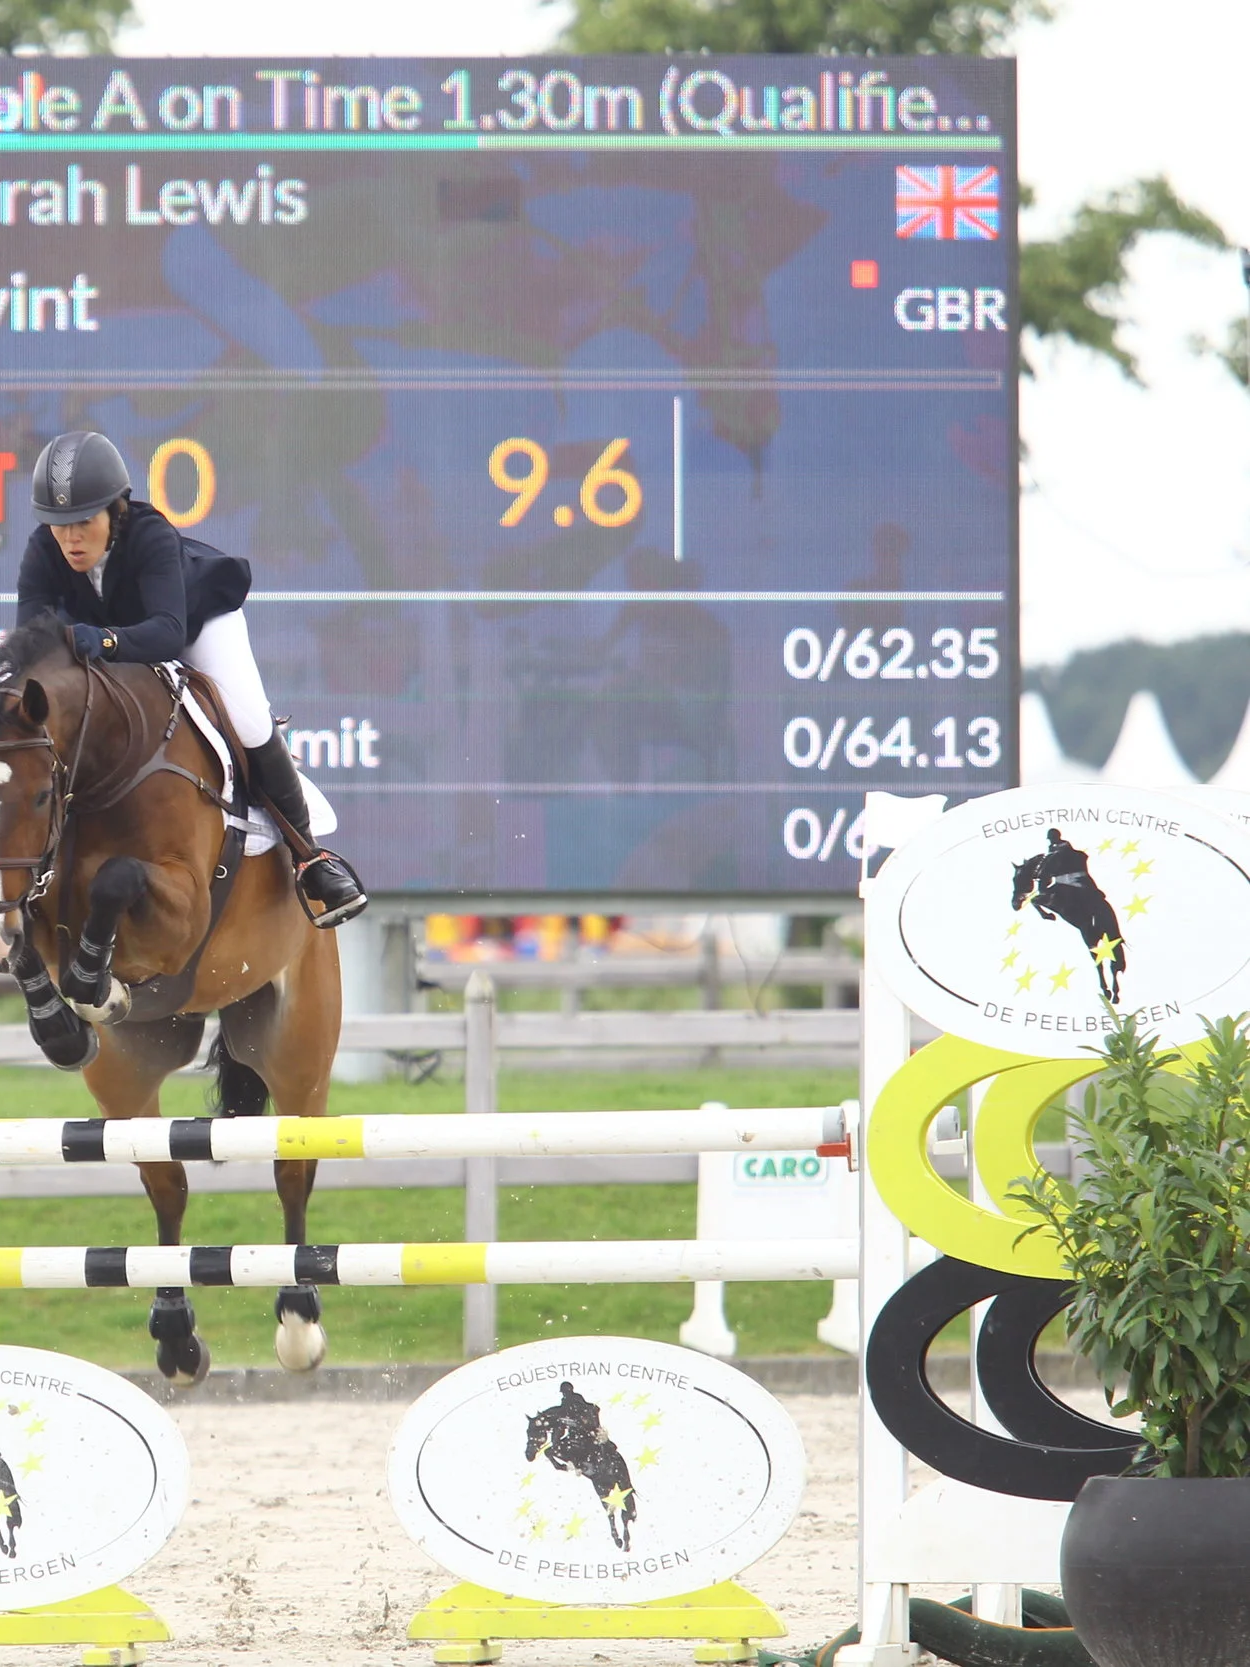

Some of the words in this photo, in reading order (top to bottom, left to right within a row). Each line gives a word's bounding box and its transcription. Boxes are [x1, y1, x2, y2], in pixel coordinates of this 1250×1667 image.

[91, 71, 148, 131] A
[159, 85, 243, 131] on
[256, 71, 421, 131] Time
[441, 70, 644, 131] 1.30m
[659, 66, 991, 136] (Qualifie...
[125, 164, 307, 225] Lewis
[894, 288, 1006, 331] GBR
[148, 437, 215, 528] 0
[488, 437, 643, 528] 9.6
[783, 627, 1000, 682] 0/62.35
[278, 716, 382, 768] mit
[783, 716, 1000, 771] 0/64.13
[783, 808, 880, 862] 0/6
[981, 808, 1100, 839] EQUESTRIAN
[1106, 808, 1180, 837] CENTRE
[983, 1002, 1014, 1023] DE
[743, 1156, 820, 1178] CARO
[0, 1370, 73, 1396] CENTRE
[496, 1361, 611, 1392] EQUESTRIAN
[617, 1362, 690, 1391] CENTRE
[499, 1549, 526, 1571] DE
[537, 1548, 690, 1579] PEELBERGEN
